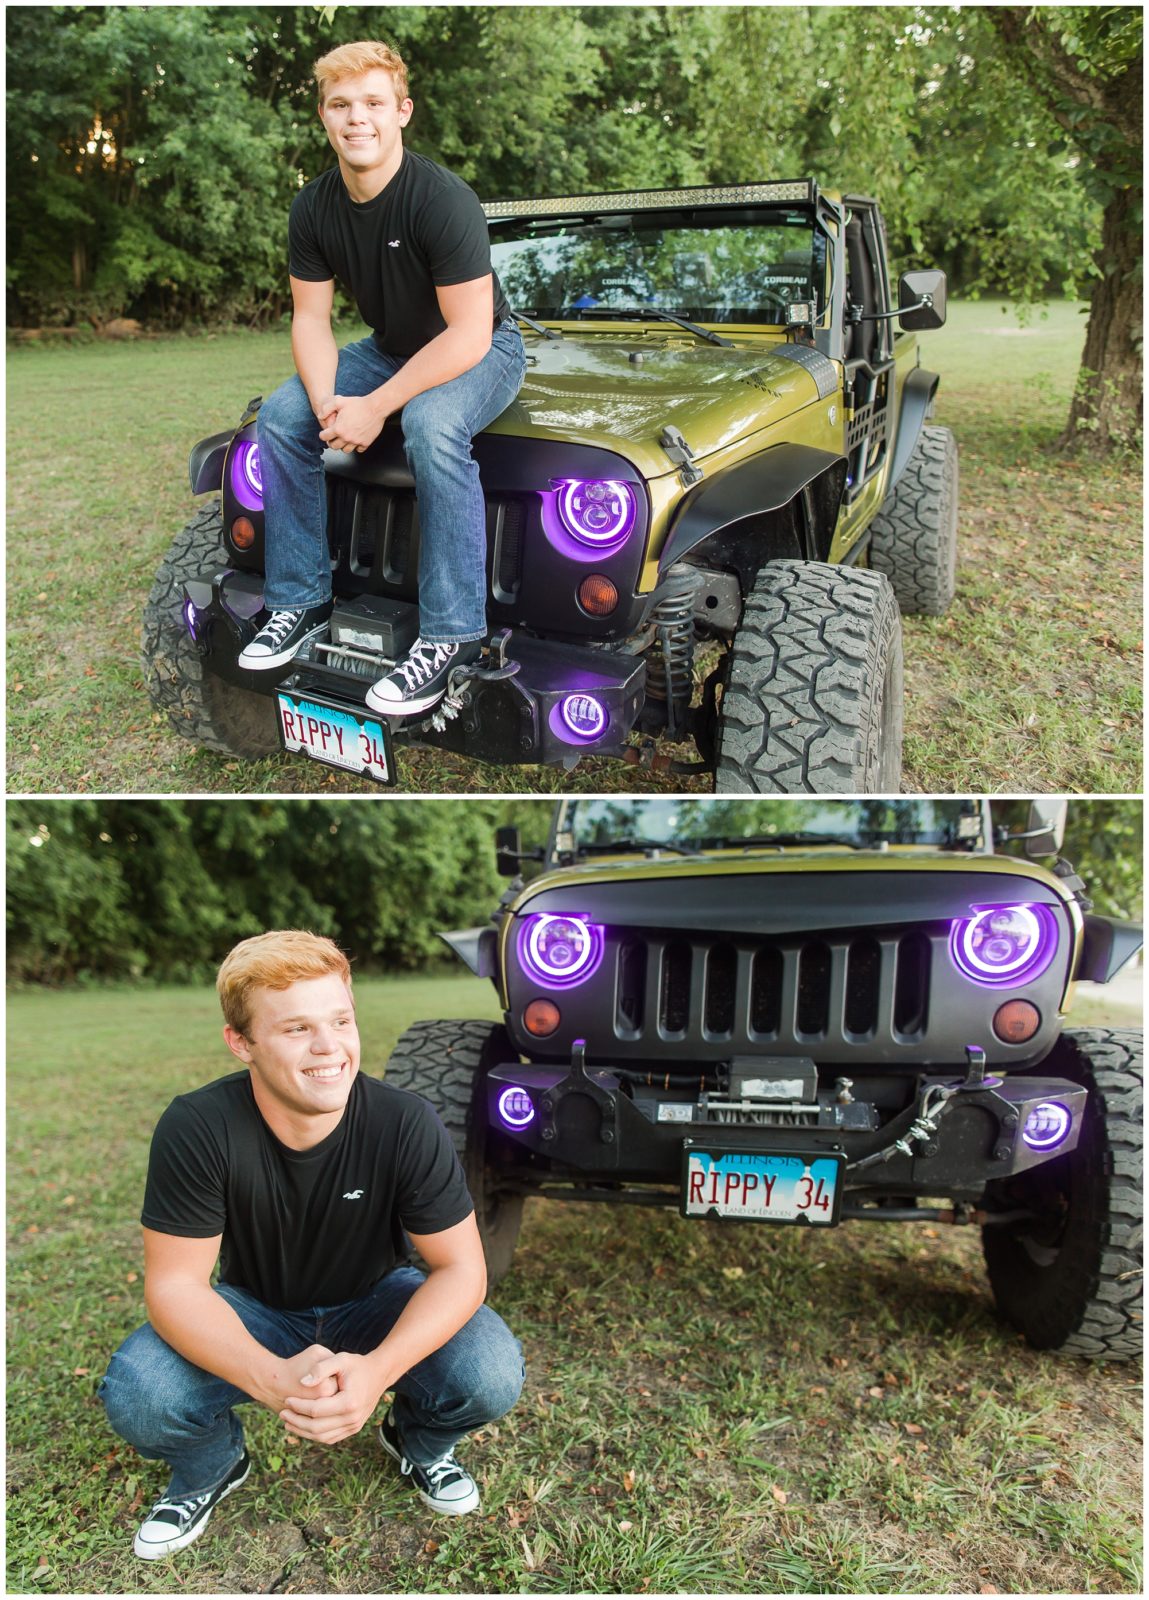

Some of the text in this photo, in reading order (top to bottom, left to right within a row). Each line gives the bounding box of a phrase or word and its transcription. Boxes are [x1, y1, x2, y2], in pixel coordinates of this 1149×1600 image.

[764, 276, 808, 285] CORBEAU
[282, 710, 385, 770] RIPPY 34
[689, 1171, 830, 1212] RIPPY 34
